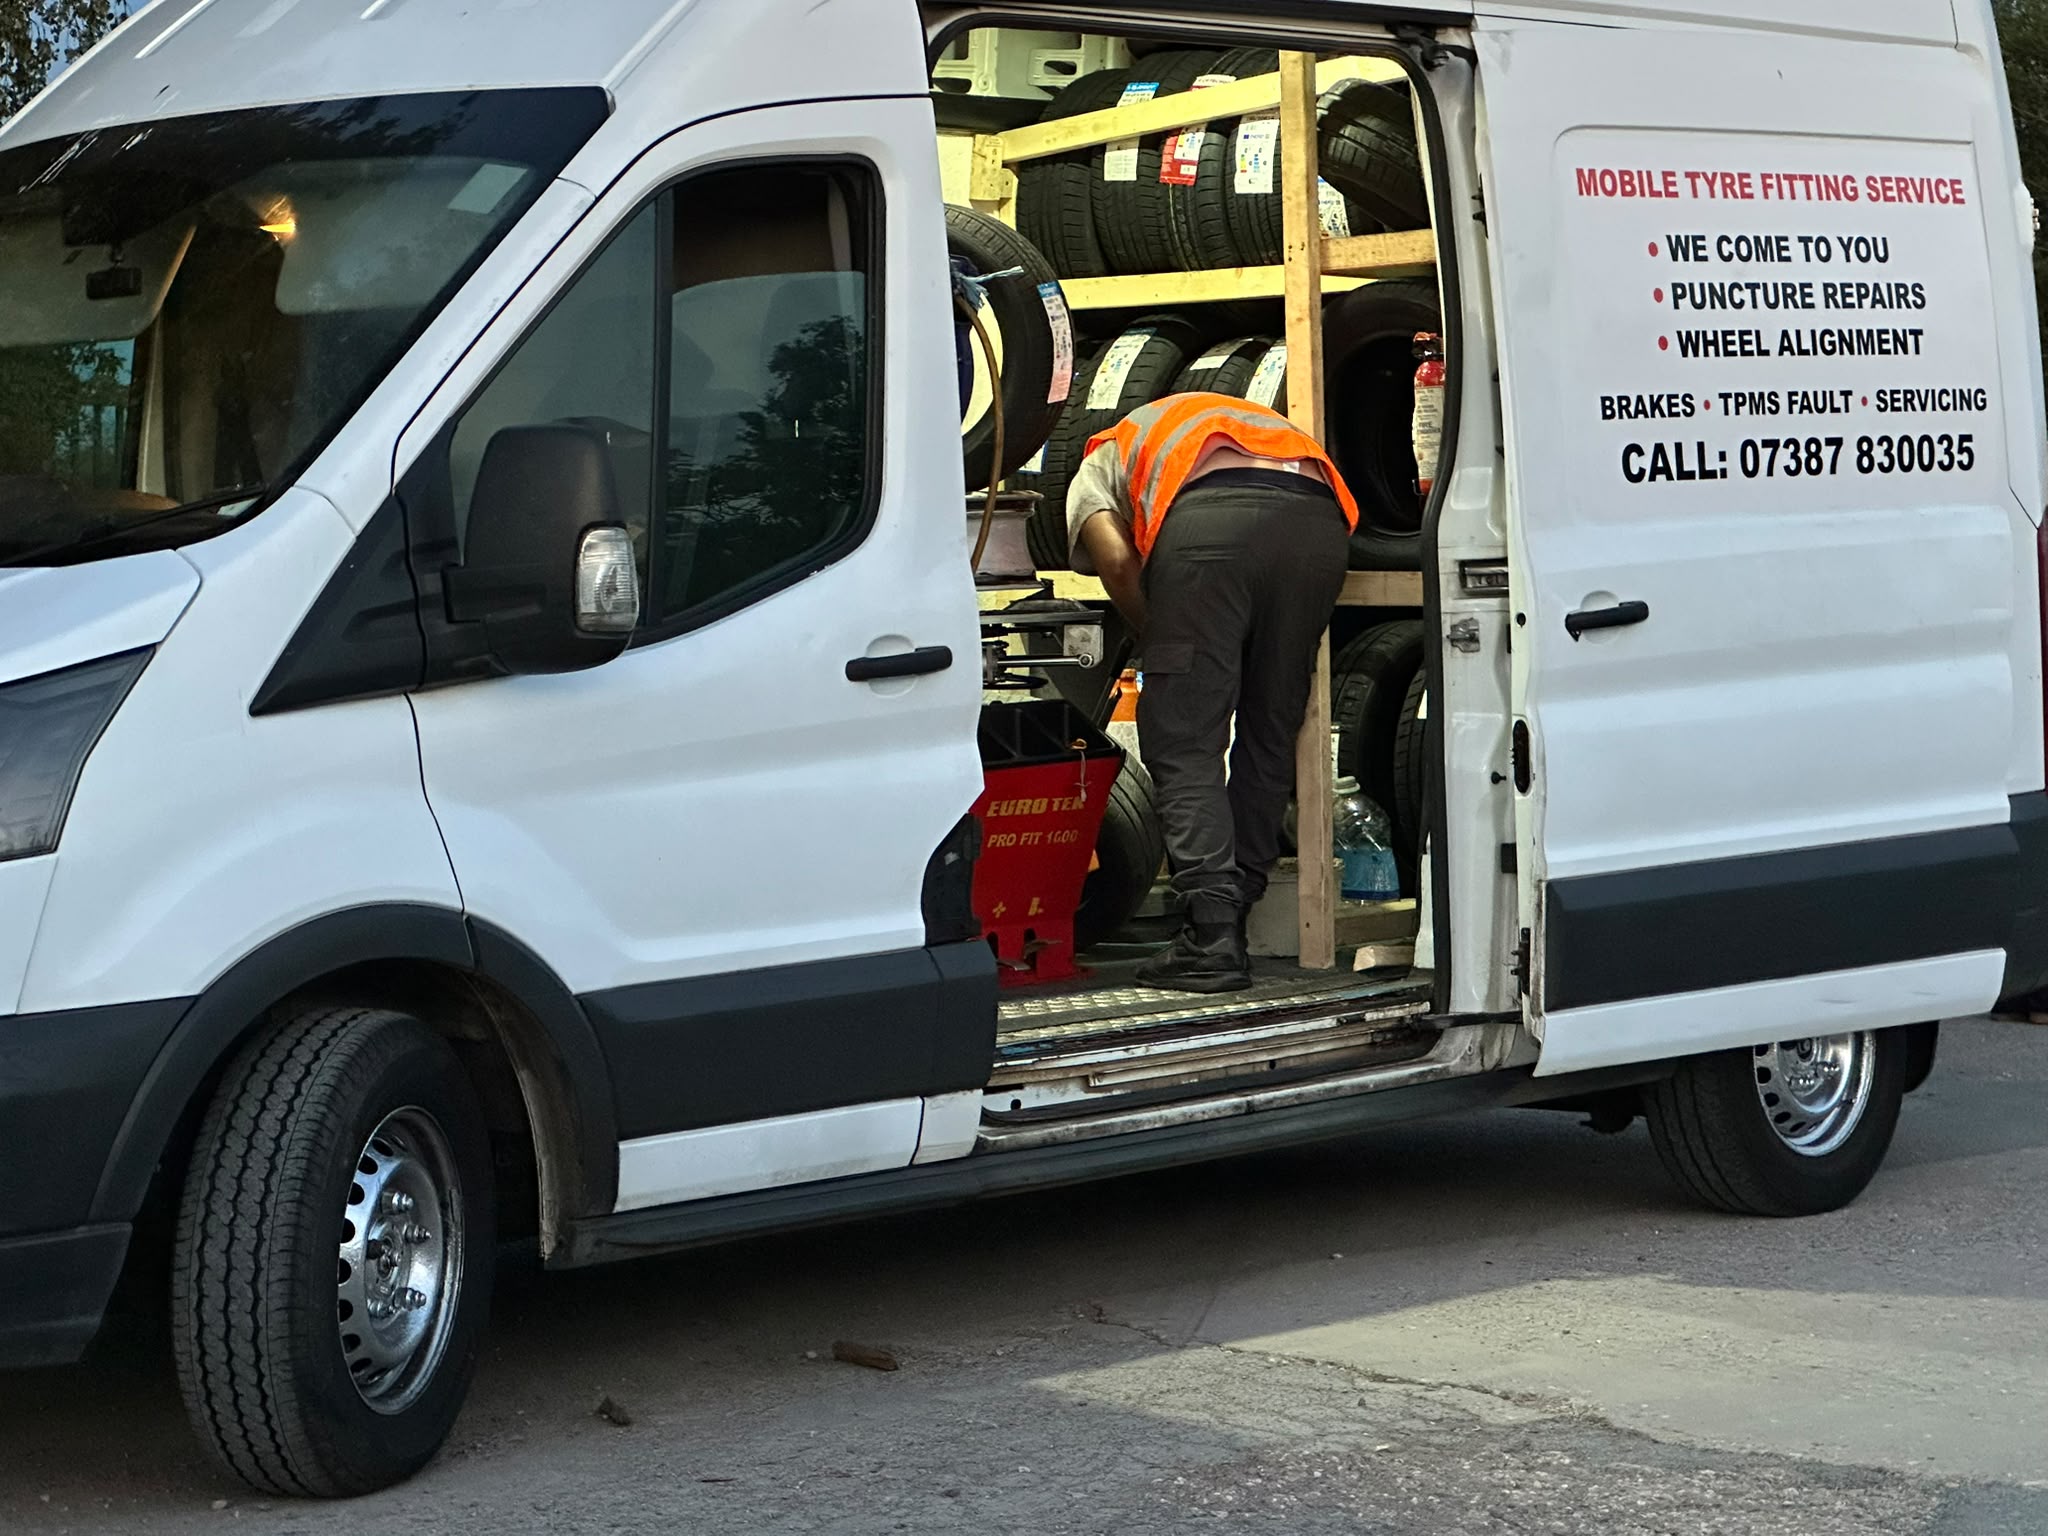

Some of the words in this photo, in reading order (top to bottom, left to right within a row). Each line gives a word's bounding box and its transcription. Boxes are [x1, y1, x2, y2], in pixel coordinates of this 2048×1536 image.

[1576, 167, 1679, 198] MOBILE
[1685, 171, 1755, 199] TYRE
[1760, 173, 1859, 202] FITTING
[1866, 175, 1966, 205] SERVICE
[1665, 234, 1709, 263] WE
[1716, 234, 1792, 263] COME
[1798, 235, 1832, 264] TO
[1836, 236, 1890, 264] YOU
[1671, 281, 1816, 310] PUNCTURE
[1822, 282, 1927, 310] REPAIRS
[1675, 329, 1770, 358] WHEEL
[1777, 328, 1924, 357] ALIGNMENT
[1600, 392, 1696, 421] BRAKES
[1717, 391, 1781, 417] TPMS
[1787, 389, 1854, 416] FAULT
[1875, 387, 1988, 413] SERVICING
[1621, 440, 1729, 484] CALL:
[1739, 436, 1844, 479] 07387
[1855, 434, 1975, 474] 830035
[986, 797, 1049, 817] EURO
[986, 833, 1017, 848] PRO
[1019, 831, 1043, 846] FIT
